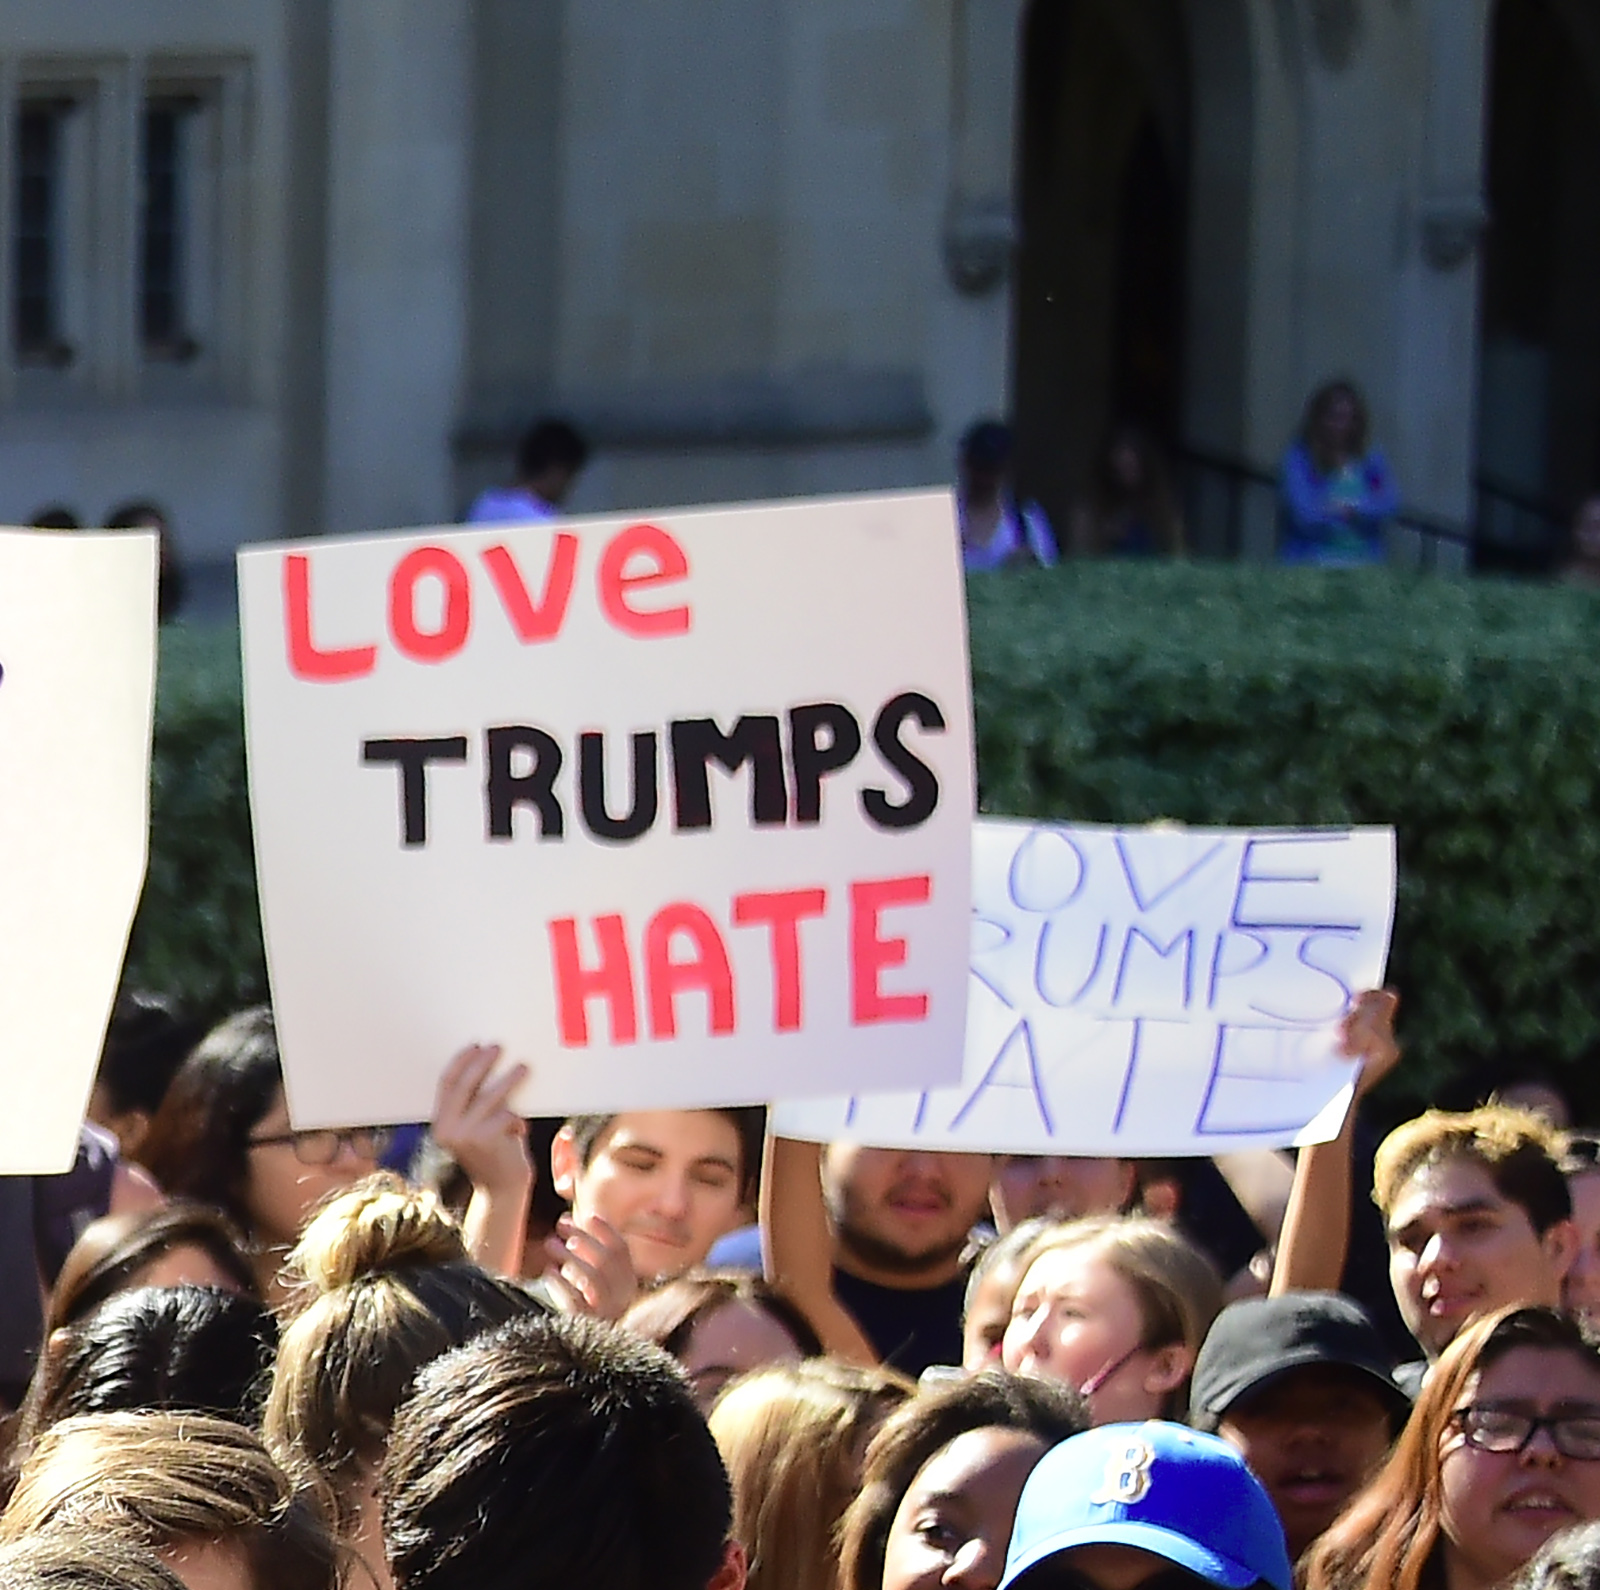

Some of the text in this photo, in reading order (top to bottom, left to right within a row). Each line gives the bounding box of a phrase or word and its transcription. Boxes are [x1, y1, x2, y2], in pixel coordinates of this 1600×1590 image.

[363, 691, 946, 849] TRUMPS
[548, 874, 932, 1048] HATE
[846, 1016, 1328, 1136] ATE
